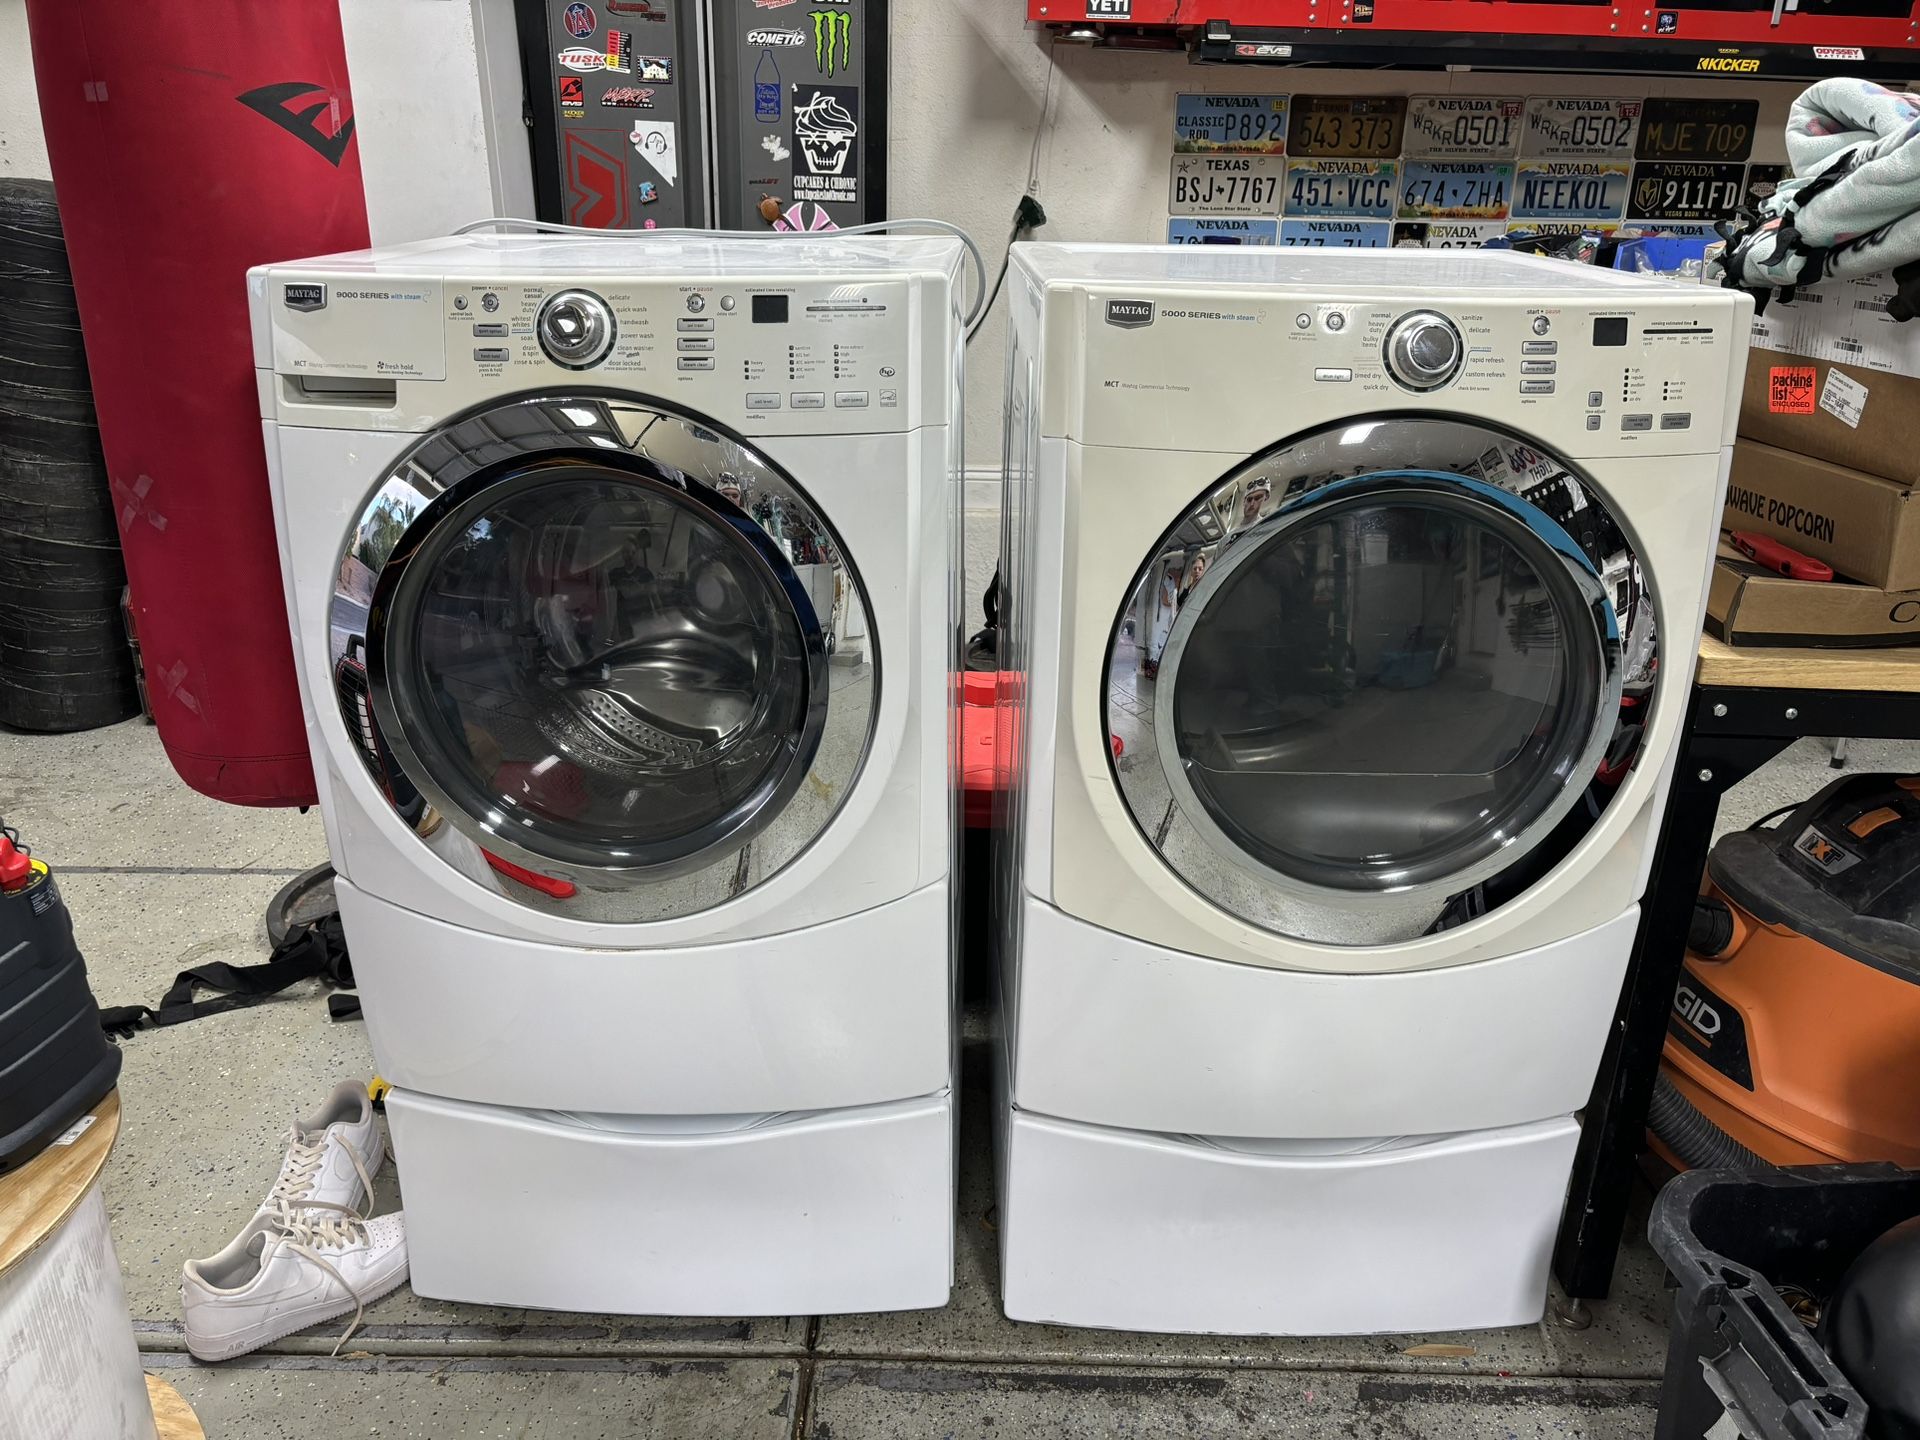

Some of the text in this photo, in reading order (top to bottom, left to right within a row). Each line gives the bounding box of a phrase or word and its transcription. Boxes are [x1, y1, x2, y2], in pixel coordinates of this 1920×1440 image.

[1090, 0, 1129, 12] YETI
[747, 30, 805, 46] COMETIC
[1815, 48, 1860, 56] ODYSSEY
[560, 54, 605, 63] TUSK
[1707, 58, 1760, 72] KICKER
[1205, 97, 1260, 108] NEVADA
[1438, 100, 1493, 111] NEVADA
[1556, 100, 1611, 112] NEVADA
[1177, 113, 1283, 142] CLASSIC P892
[1299, 116, 1393, 150] 543 373
[1413, 113, 1511, 147] WRKR 0501
[1531, 113, 1632, 147] WRKR 0502
[1188, 129, 1210, 140] ROD
[1644, 122, 1747, 153] MJE 709
[1206, 159, 1250, 171] TEXAS
[1317, 162, 1370, 174] NEVADA
[1430, 163, 1486, 174] NEVADA
[1546, 163, 1600, 175] NEVADA
[1663, 164, 1715, 177] NEVADA
[793, 175, 824, 188] CUPCAKES
[1175, 176, 1277, 204] BSJ 7767
[1291, 177, 1391, 208] 451 VCC
[1404, 180, 1504, 208] 674 ZHA
[1522, 180, 1611, 210] NEEKOL
[1662, 181, 1738, 210] 911FD
[1664, 210, 1683, 218] VEGAS
[1196, 220, 1250, 231] NEVADA
[1307, 222, 1361, 233] NEVADA
[1426, 225, 1477, 238] NEVADA
[1535, 224, 1588, 236] NEVADA
[287, 289, 320, 298] MAYTAG
[336, 291, 359, 299] 9000
[359, 292, 390, 300] SERIES
[615, 306, 632, 314] quick
[1111, 305, 1149, 315] MAYTAG
[1161, 309, 1186, 318] 5000
[1187, 311, 1221, 320] SERIES
[1103, 380, 1120, 388] MCT
[1772, 373, 1813, 388] packing
[1379, 384, 1390, 392] dry
[1772, 386, 1788, 401] list
[1772, 400, 1810, 408] ENCLOSED
[1726, 484, 1835, 544] WAVE POPCORN
[1799, 832, 1846, 867] NXT
[1672, 984, 1721, 1035] GID
